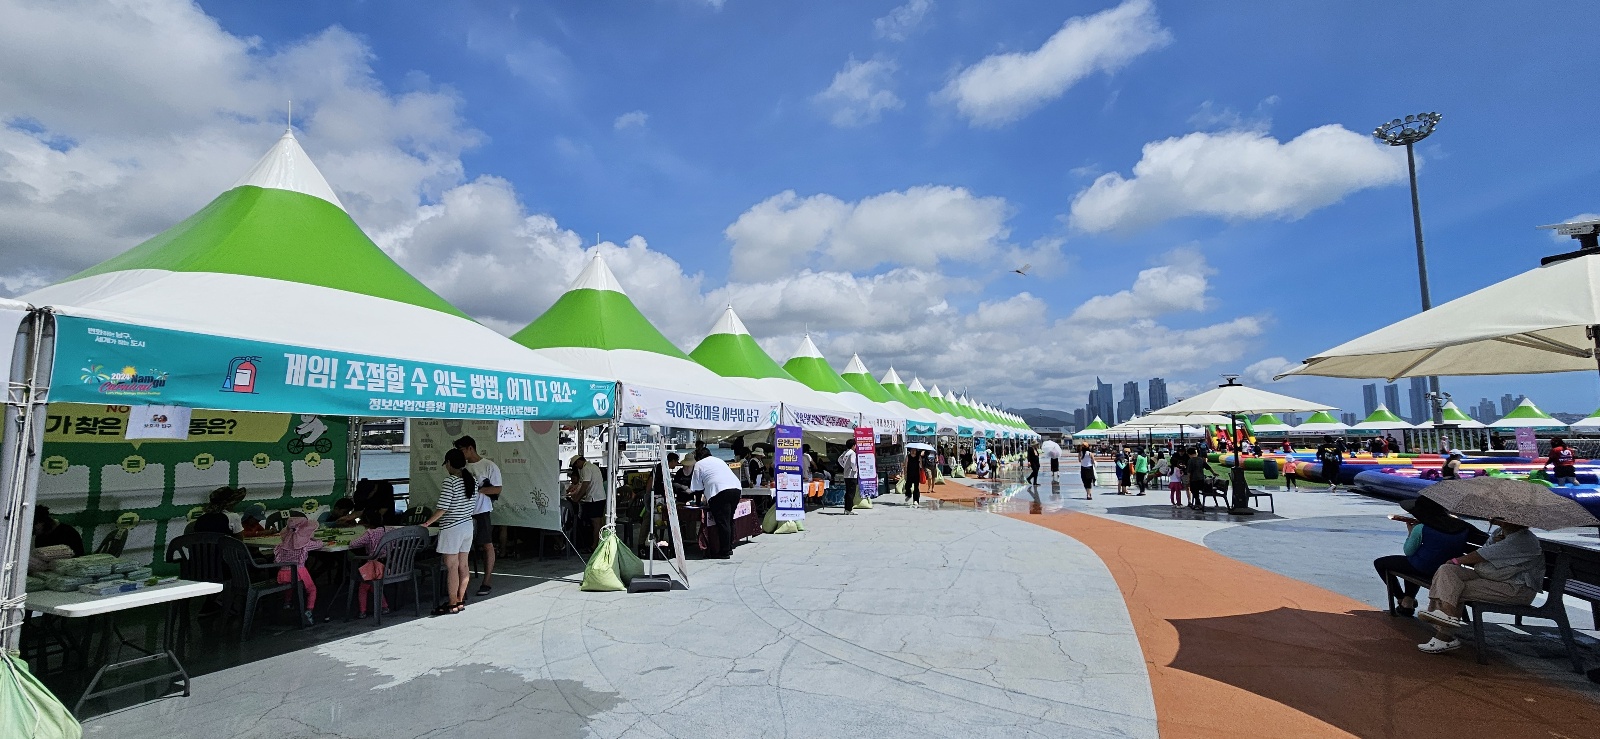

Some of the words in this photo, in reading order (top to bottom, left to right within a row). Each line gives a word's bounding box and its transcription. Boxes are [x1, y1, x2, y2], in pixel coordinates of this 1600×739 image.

[130, 339, 146, 348] 도시
[111, 372, 131, 380] 2024
[283, 353, 339, 389] 게임!
[343, 360, 405, 394] 조절할
[410, 367, 429, 395] 수
[433, 369, 467, 398] 있는
[470, 373, 503, 403] 방법,
[506, 376, 533, 402] 여기
[534, 380, 548, 402] 다
[368, 397, 446, 413] 정보산업진흥원
[665, 400, 720, 421] 육아친화마을
[722, 406, 746, 422] 어부바
[747, 409, 760, 423] 남구
[74, 416, 122, 436] 찾은
[188, 418, 238, 436] 동은?
